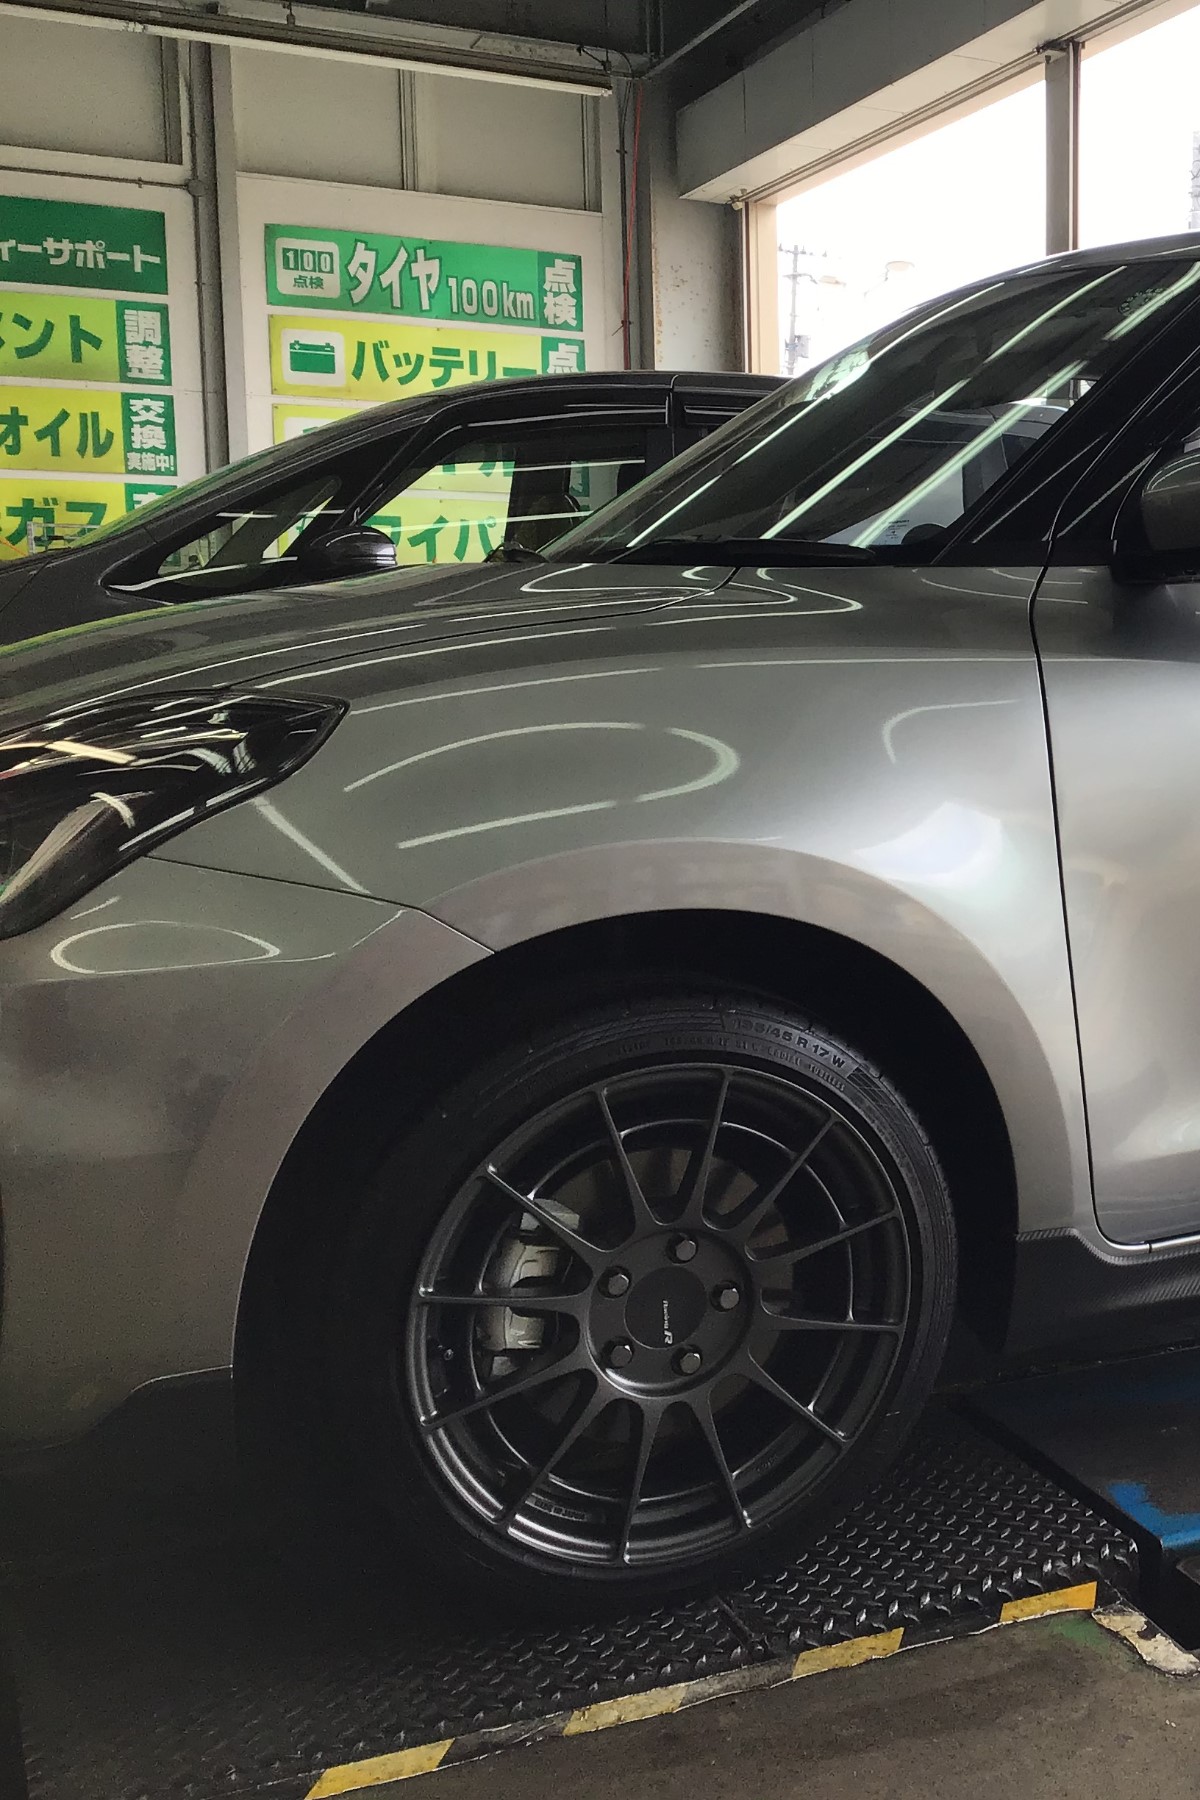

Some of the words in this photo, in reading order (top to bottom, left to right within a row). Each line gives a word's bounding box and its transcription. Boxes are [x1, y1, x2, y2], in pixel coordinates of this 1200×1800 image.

[283, 248, 333, 274] 100
[292, 275, 324, 291] 点検
[347, 239, 442, 312] タイヤ
[544, 258, 578, 328] 点検
[0, 310, 103, 363] ント
[123, 308, 165, 380] 調整
[351, 340, 537, 388] バッテリー
[0, 406, 115, 459] オイル
[129, 398, 166, 450] 交換
[812, 1044, 830, 1058] 17
